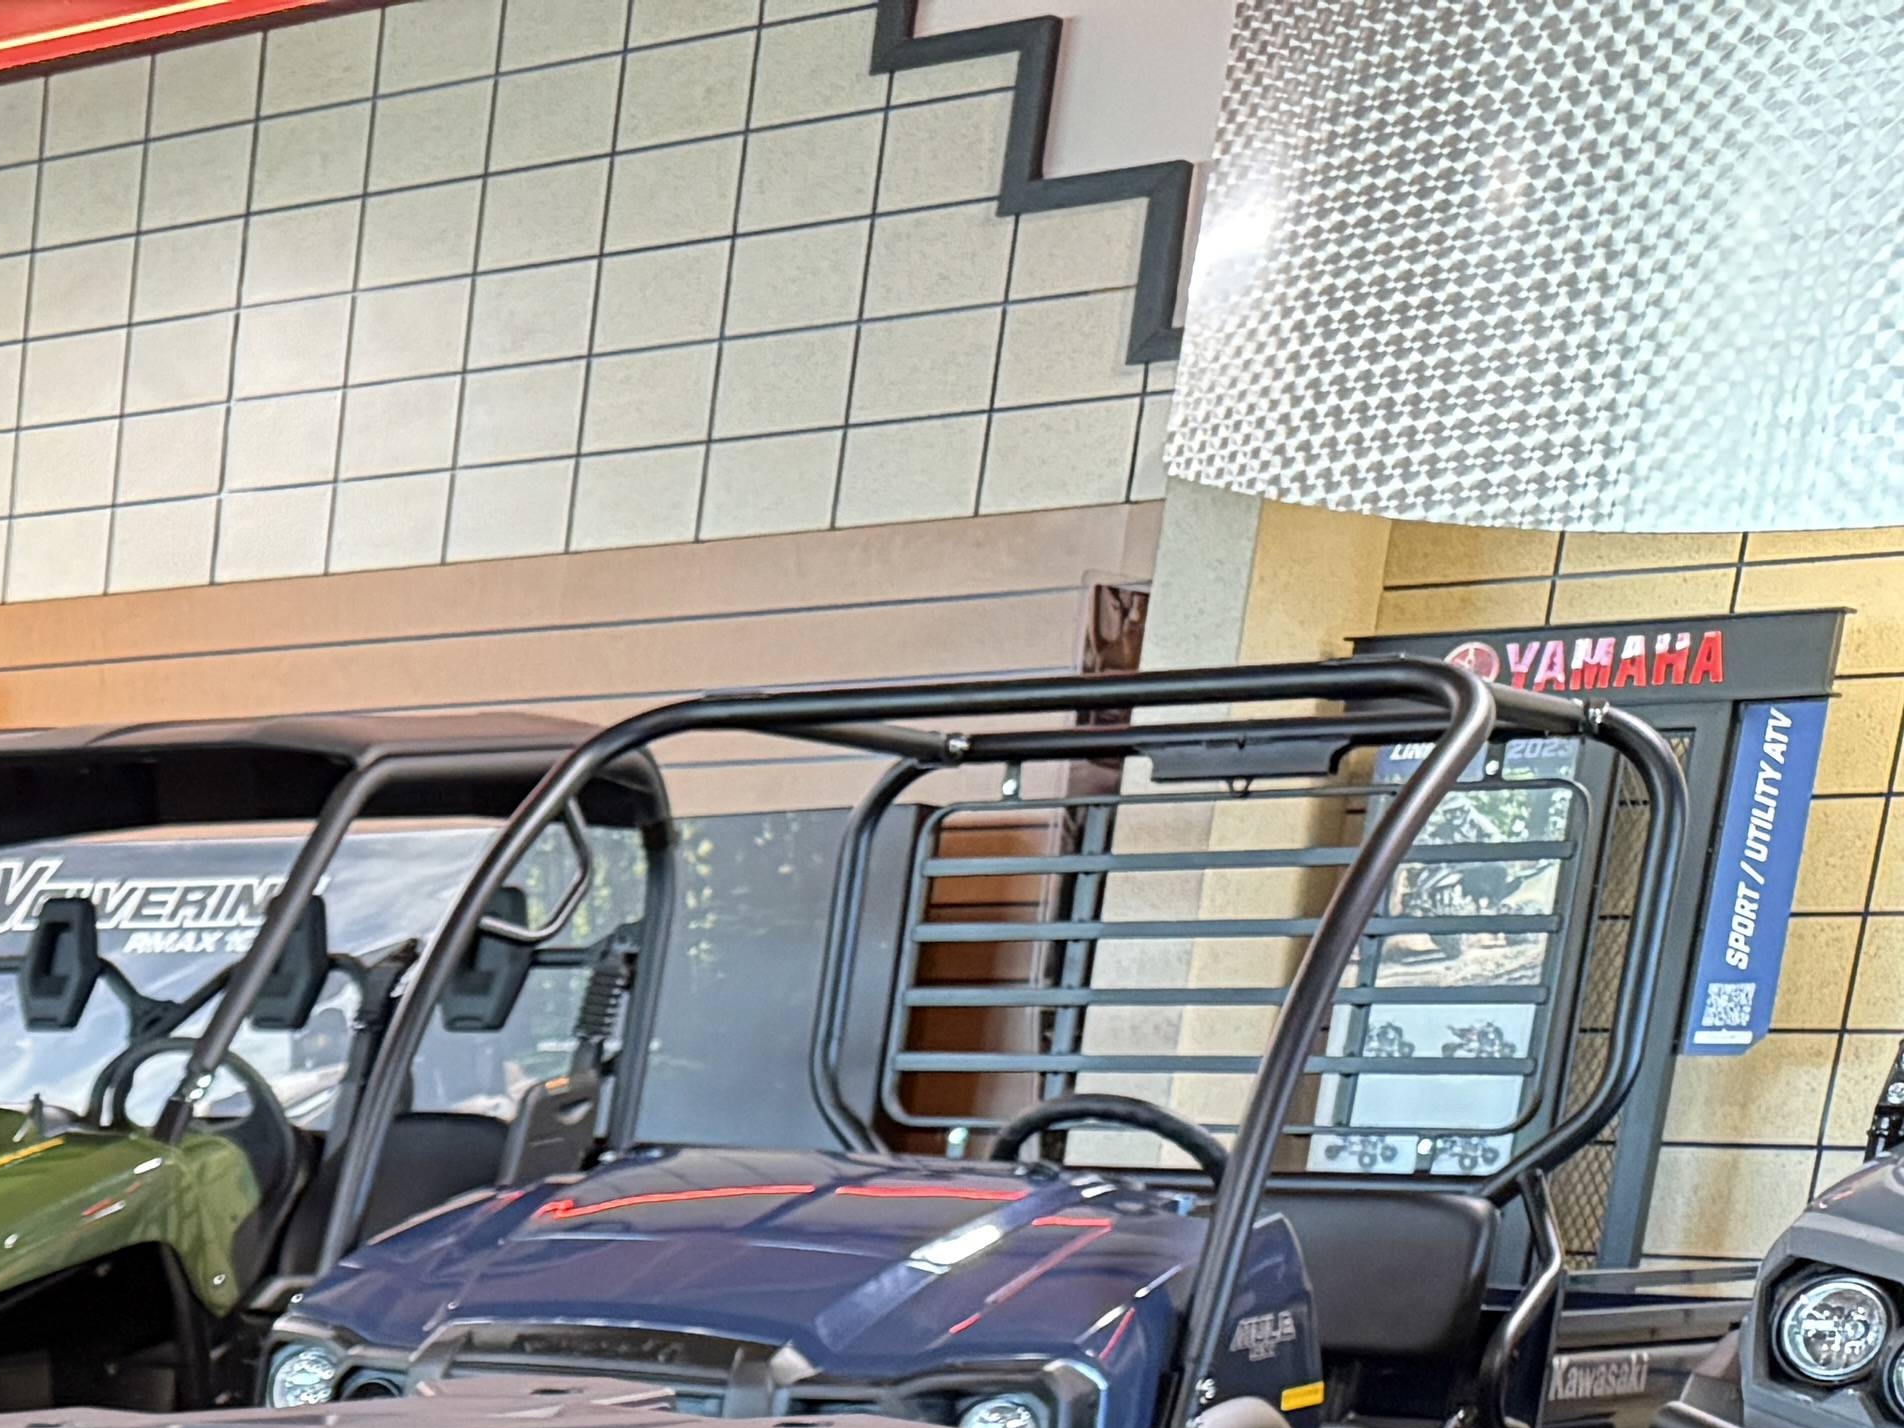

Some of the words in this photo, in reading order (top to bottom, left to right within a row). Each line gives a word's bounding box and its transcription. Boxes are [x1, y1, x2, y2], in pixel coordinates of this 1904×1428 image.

[1506, 631, 1724, 691] YAMAHA
[1763, 707, 1793, 765] ATV
[1745, 760, 1782, 862] UTILITY
[1740, 860, 1765, 885] /
[1726, 881, 1760, 970] SPORT
[1550, 1353, 1649, 1400] Kawasaki
